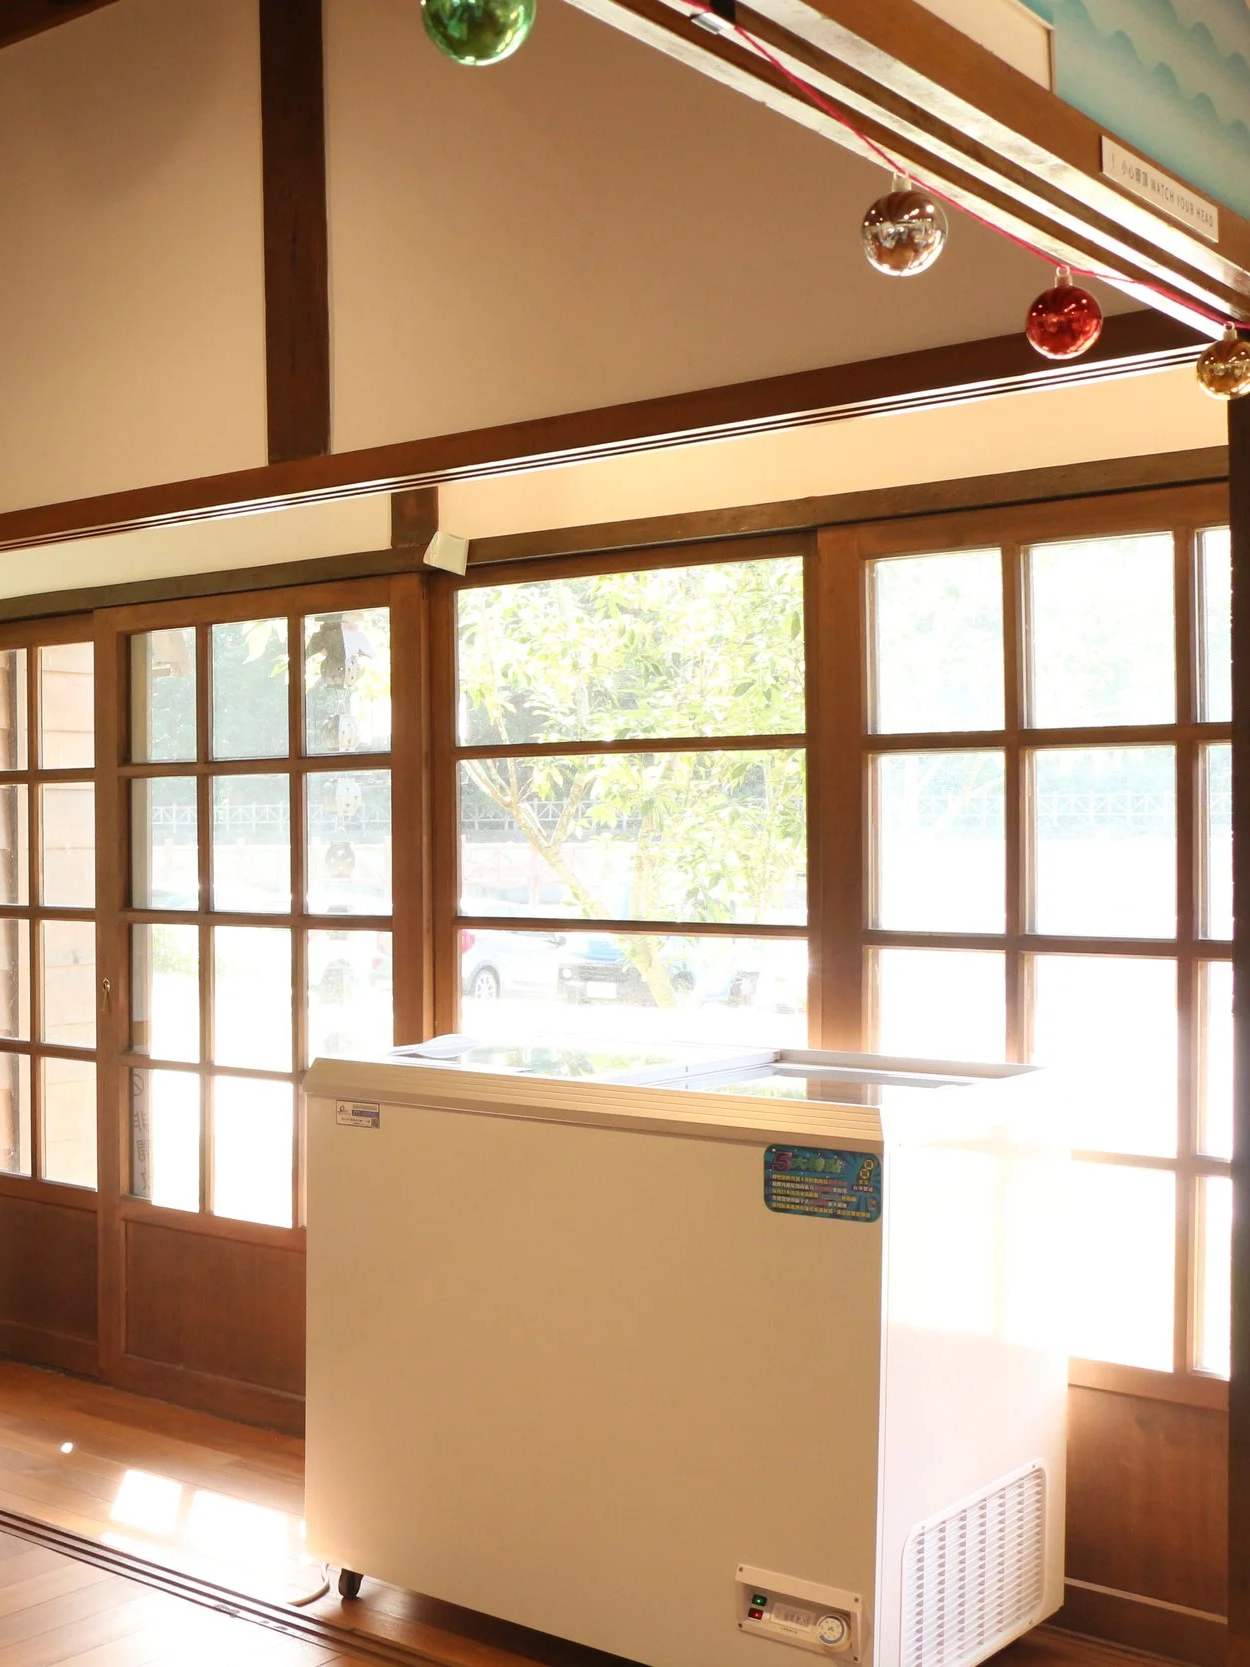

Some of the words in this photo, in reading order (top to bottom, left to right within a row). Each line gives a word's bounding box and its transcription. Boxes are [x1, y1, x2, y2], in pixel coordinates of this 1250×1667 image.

[1151, 179, 1175, 203] WATCH
[1177, 195, 1195, 215] YOUR
[1196, 207, 1214, 228] HEAD
